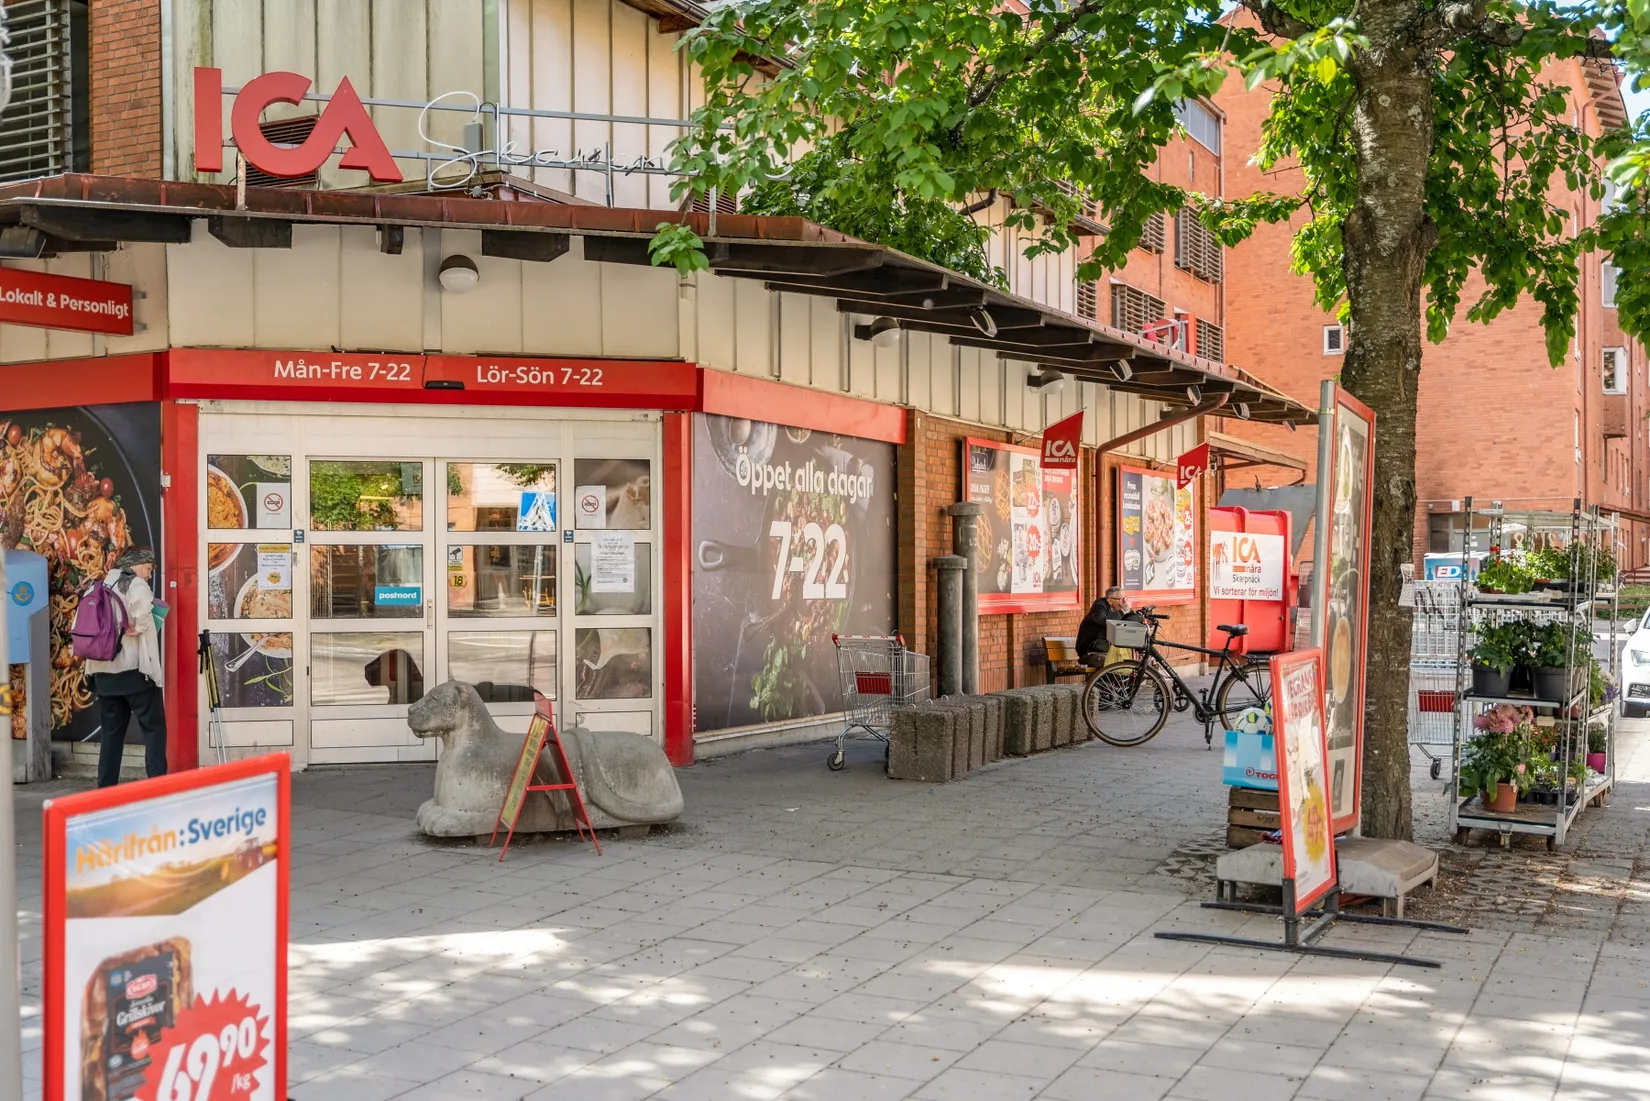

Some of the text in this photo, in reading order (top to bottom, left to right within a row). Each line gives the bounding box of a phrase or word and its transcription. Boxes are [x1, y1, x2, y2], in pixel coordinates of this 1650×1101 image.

[194, 68, 404, 183] ICA
[0, 286, 129, 319] Lokalt & Personligt
[274, 360, 411, 381] Mån-Fre 7-22
[476, 365, 604, 386] Lör-Sön 7-22
[1045, 440, 1076, 457] ICA
[1060, 455, 1076, 463] nära
[736, 446, 873, 504] Öppet alla dagar
[1232, 536, 1261, 563] ICA
[769, 521, 848, 600] 7-22
[1246, 564, 1262, 574] nära
[453, 575, 464, 586] 18
[1232, 574, 1261, 584] Skarpnäck
[379, 591, 418, 600] postnord
[1213, 586, 1279, 599] Vi sorterar för miljön!
[231, 1073, 252, 1094] /kg
